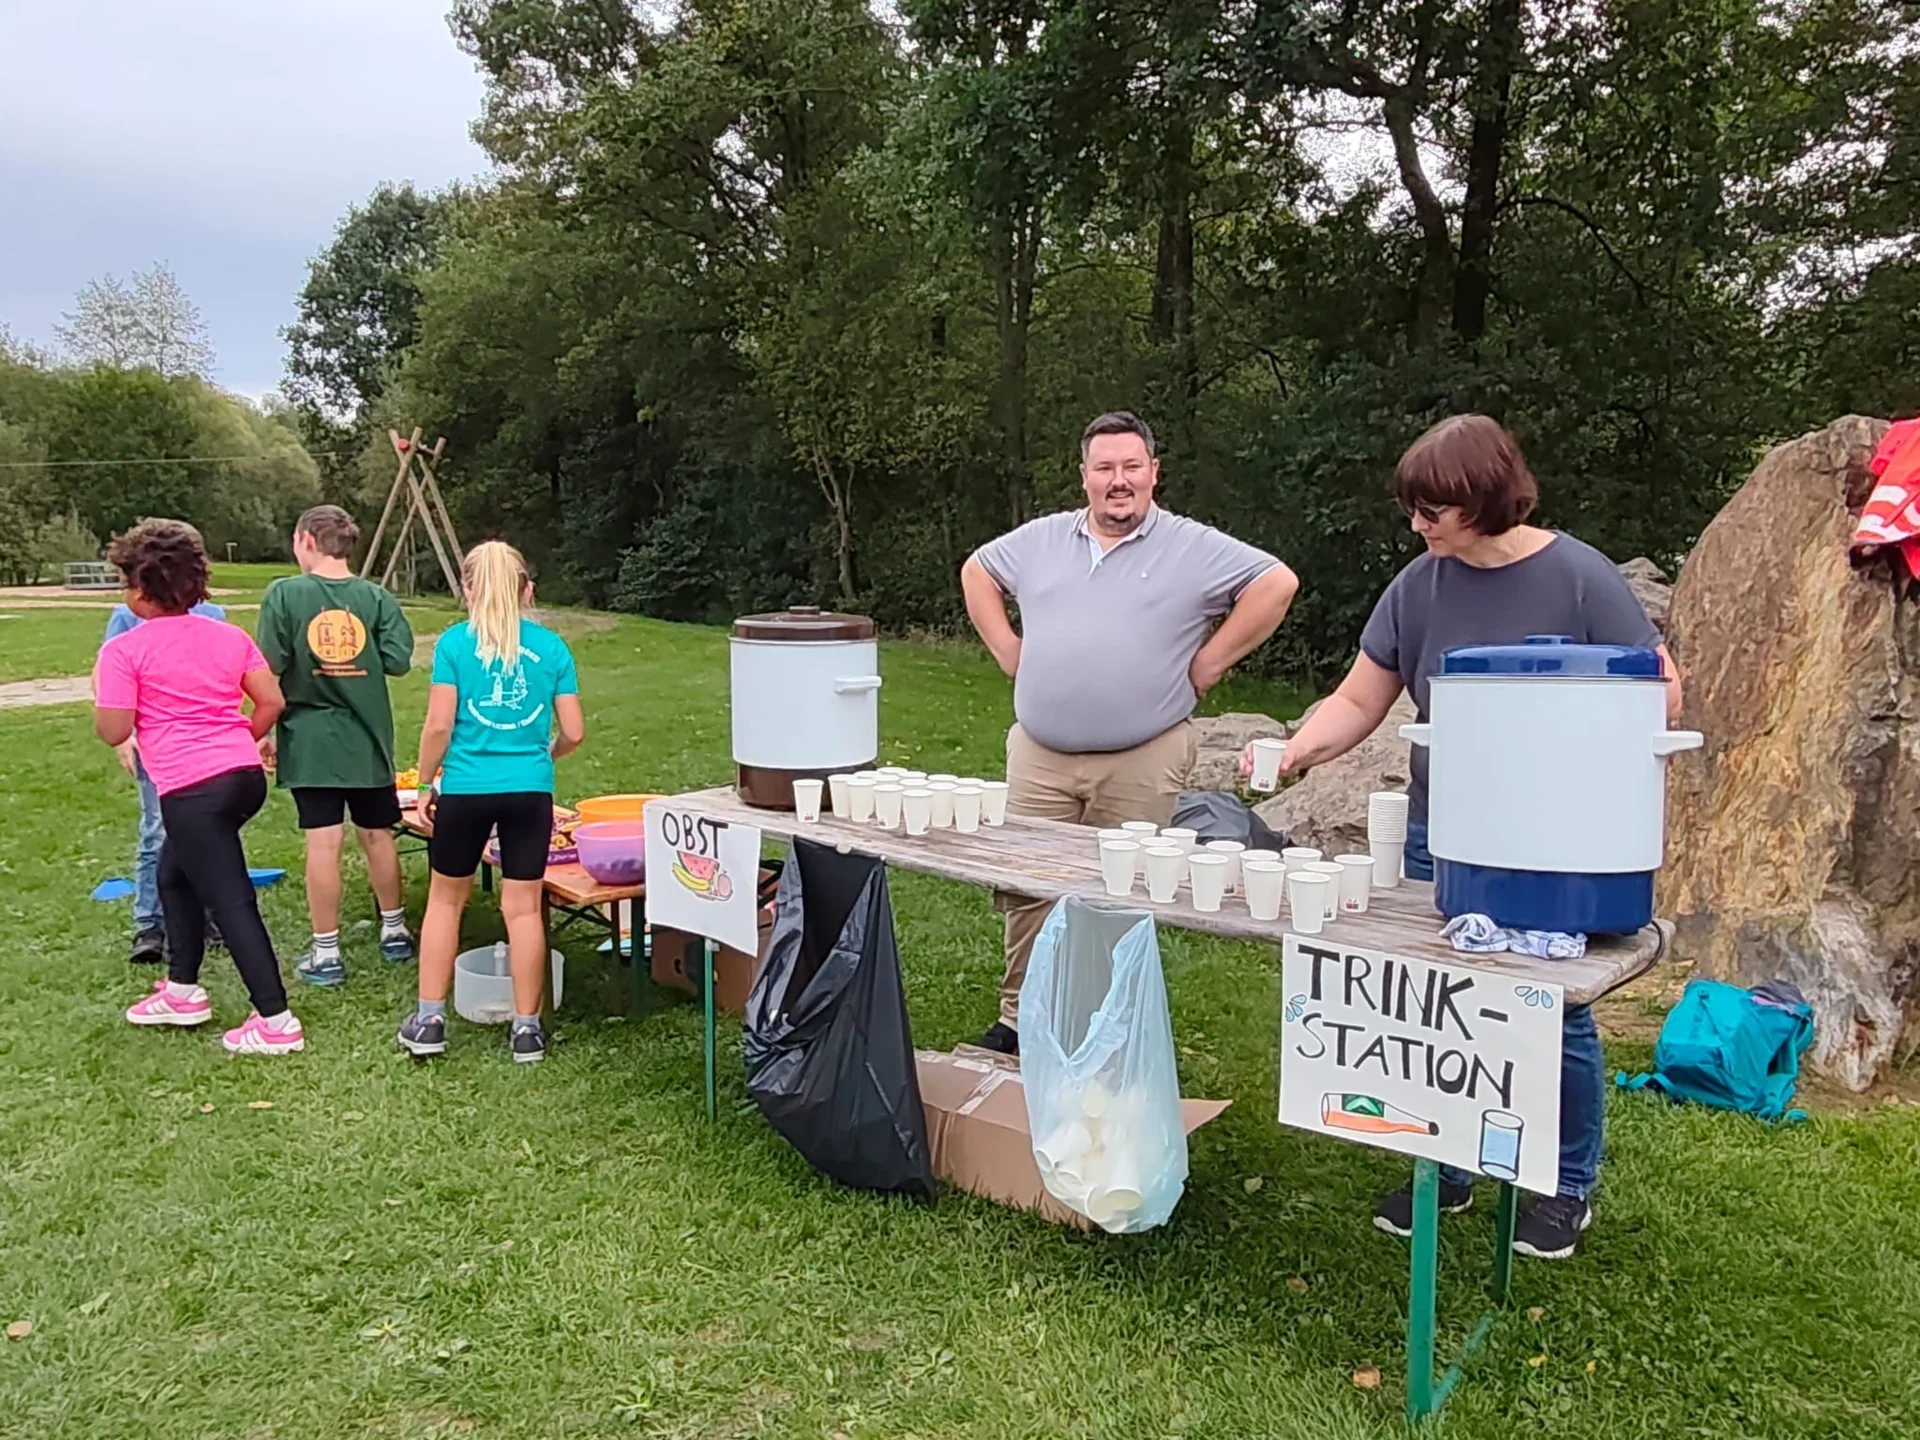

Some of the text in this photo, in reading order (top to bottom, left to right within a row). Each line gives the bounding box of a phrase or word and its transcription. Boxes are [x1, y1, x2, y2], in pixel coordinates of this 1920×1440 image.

[663, 812, 728, 858] OBST
[1298, 944, 1508, 1040] TRINK-
[1296, 1013, 1514, 1109] STATION
